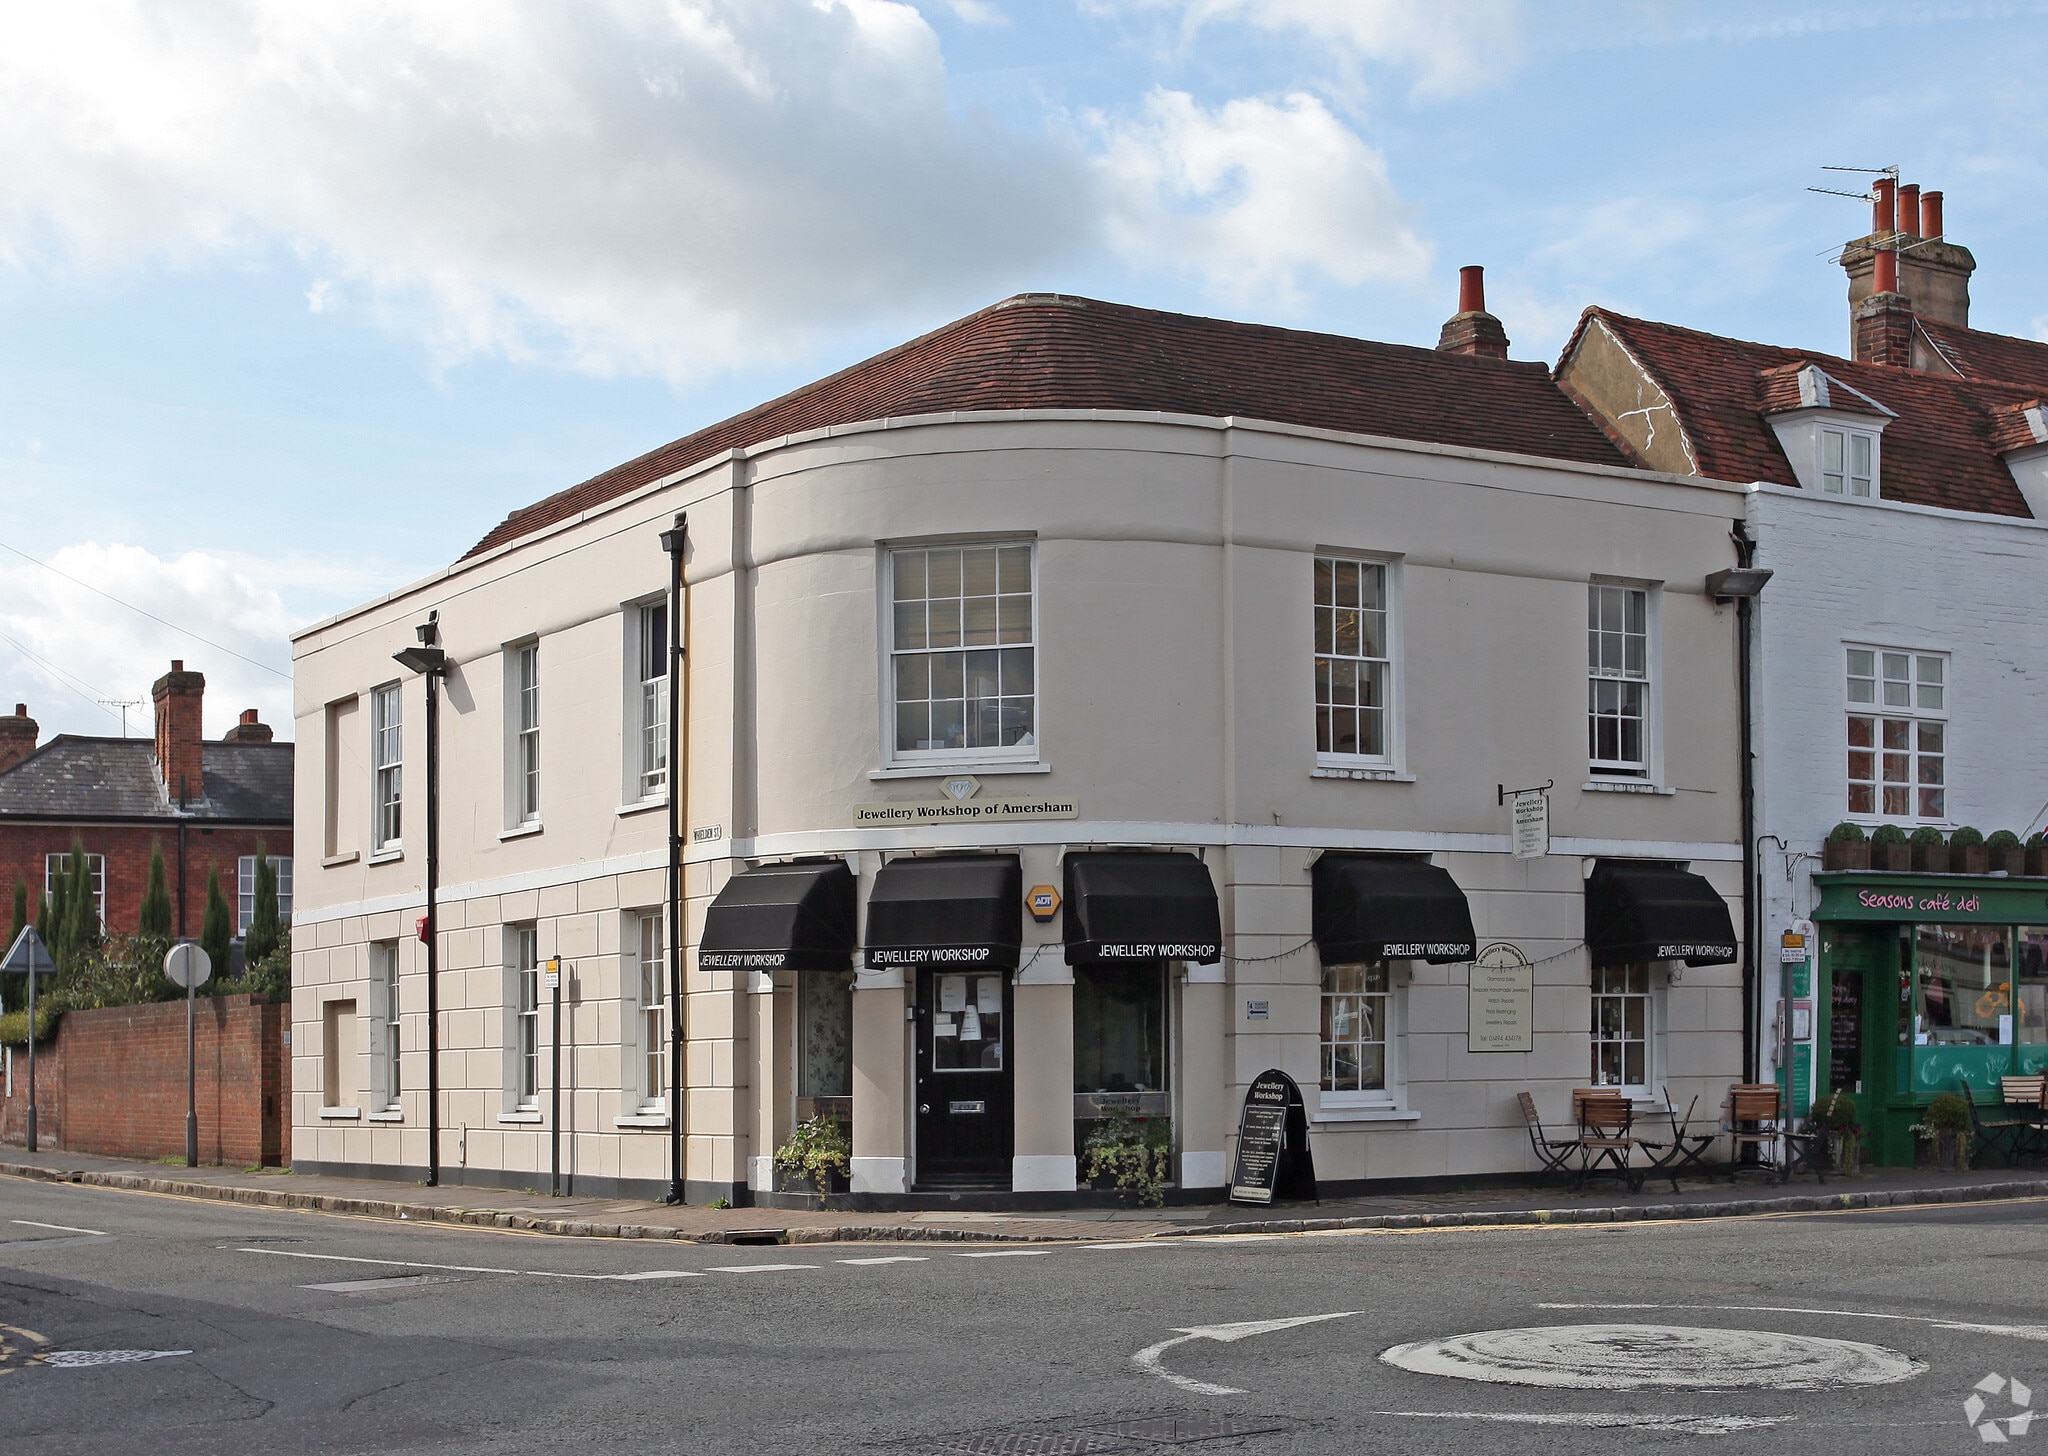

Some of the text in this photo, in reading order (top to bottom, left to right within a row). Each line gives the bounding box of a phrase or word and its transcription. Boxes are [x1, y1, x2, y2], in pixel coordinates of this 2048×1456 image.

[1515, 799, 1543, 808] Jewellery
[857, 802, 1073, 820] Jewellery Workshop of Amersham
[1515, 806, 1543, 814] Workshop
[1515, 816, 1544, 825] Amersham
[1035, 896, 1052, 906] ADT
[1858, 890, 1914, 910] Seasons
[872, 948, 990, 963] JEWELLERY WORKSHOP
[1098, 944, 1216, 957] JEWELLERY WORKSHOP
[1382, 943, 1470, 956] JEWELLERY WORKSHOP
[1657, 945, 1733, 958] JEWELLERY WORKSHOP
[700, 954, 786, 966] JEWELLERY WORKSHOP
[1479, 945, 1525, 967] Jewellery Workshop
[1256, 1081, 1285, 1092] Jewellery
[1101, 1097, 1140, 1105] Jewellery
[1254, 1092, 1283, 1102] Workshop
